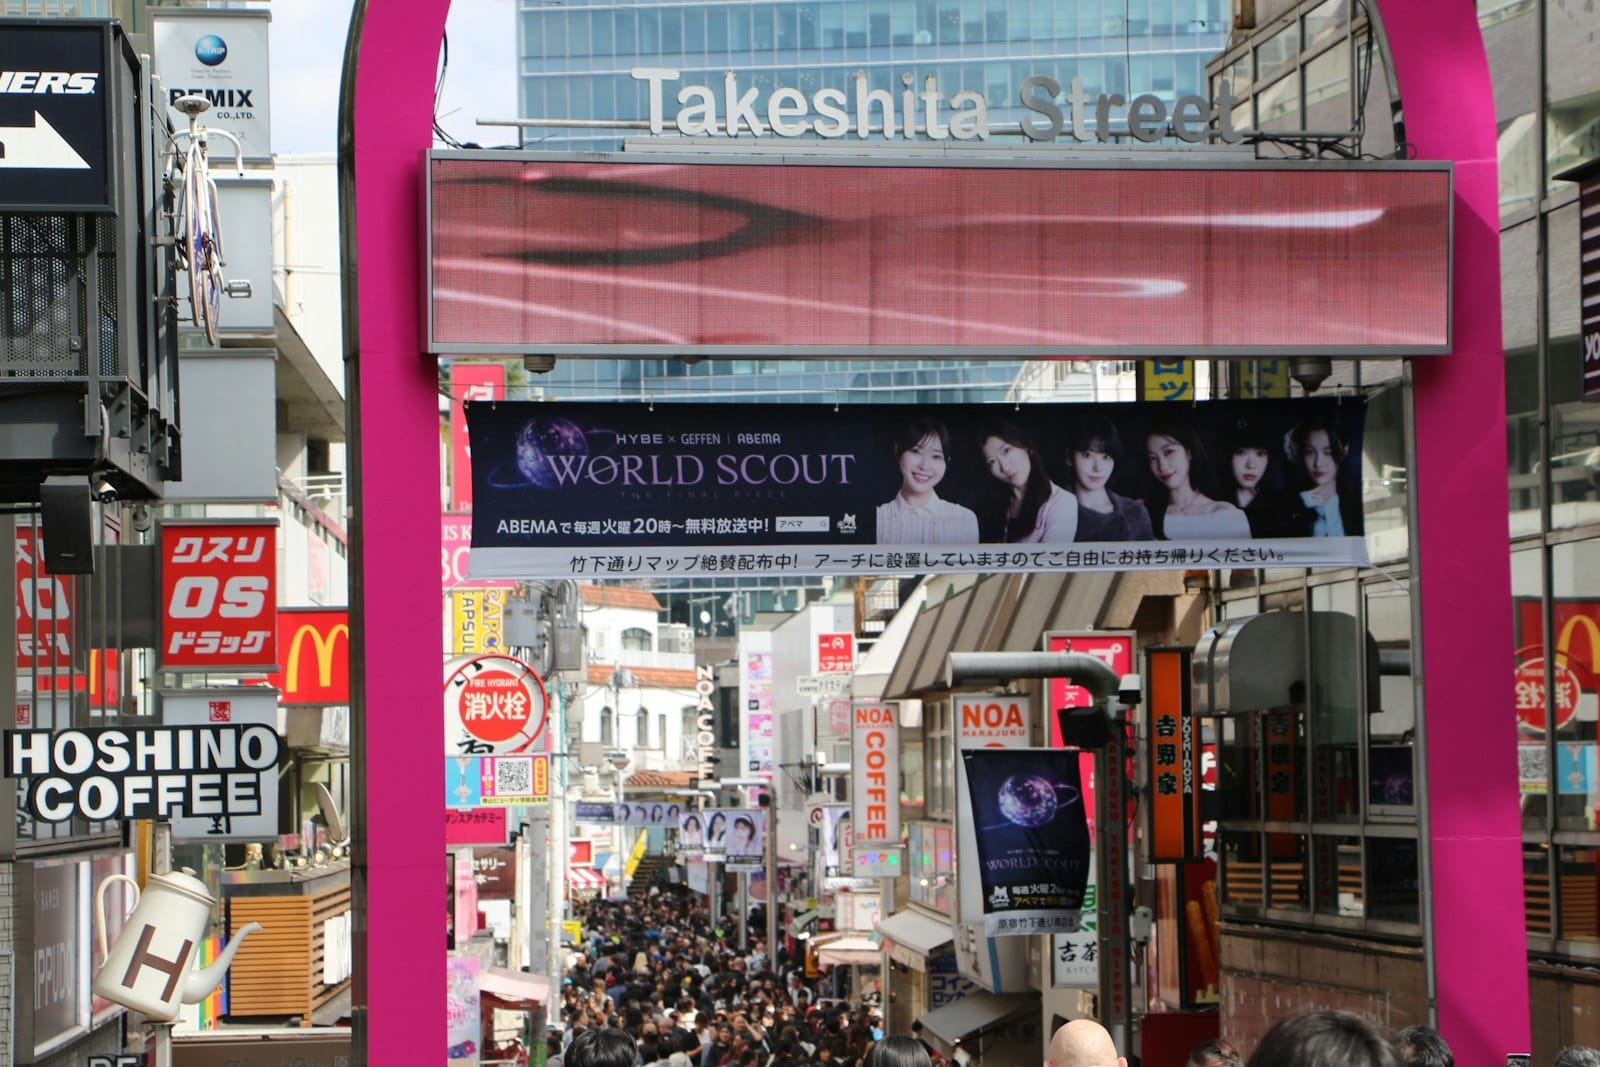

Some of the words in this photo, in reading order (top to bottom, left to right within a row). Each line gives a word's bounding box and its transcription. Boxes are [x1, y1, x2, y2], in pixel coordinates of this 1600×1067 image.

[630, 67, 991, 141] Takeshita
[1018, 73, 1248, 144] Street
[616, 433, 663, 445] HYBE
[681, 433, 721, 446] GEFFEN
[737, 433, 782, 445] ABEMA
[545, 453, 704, 487] WORLD
[717, 453, 856, 486] SCOUT
[171, 537, 265, 563] クスリ
[570, 553, 798, 573] 竹下通りマップ絶賛配布中!
[168, 575, 269, 619] OS
[168, 631, 271, 655] ドラッグ
[470, 679, 485, 687] FIRE
[487, 679, 519, 688] HYDRANT
[464, 691, 527, 720] 消火栓
[856, 708, 894, 724] NOA
[962, 703, 1024, 729] NOA
[962, 729, 1026, 737] HARAJUKU
[12, 725, 279, 775] HOSHINO
[35, 772, 259, 821] COFFEE
[865, 731, 887, 840] COFFEE
[121, 924, 193, 1003] H
